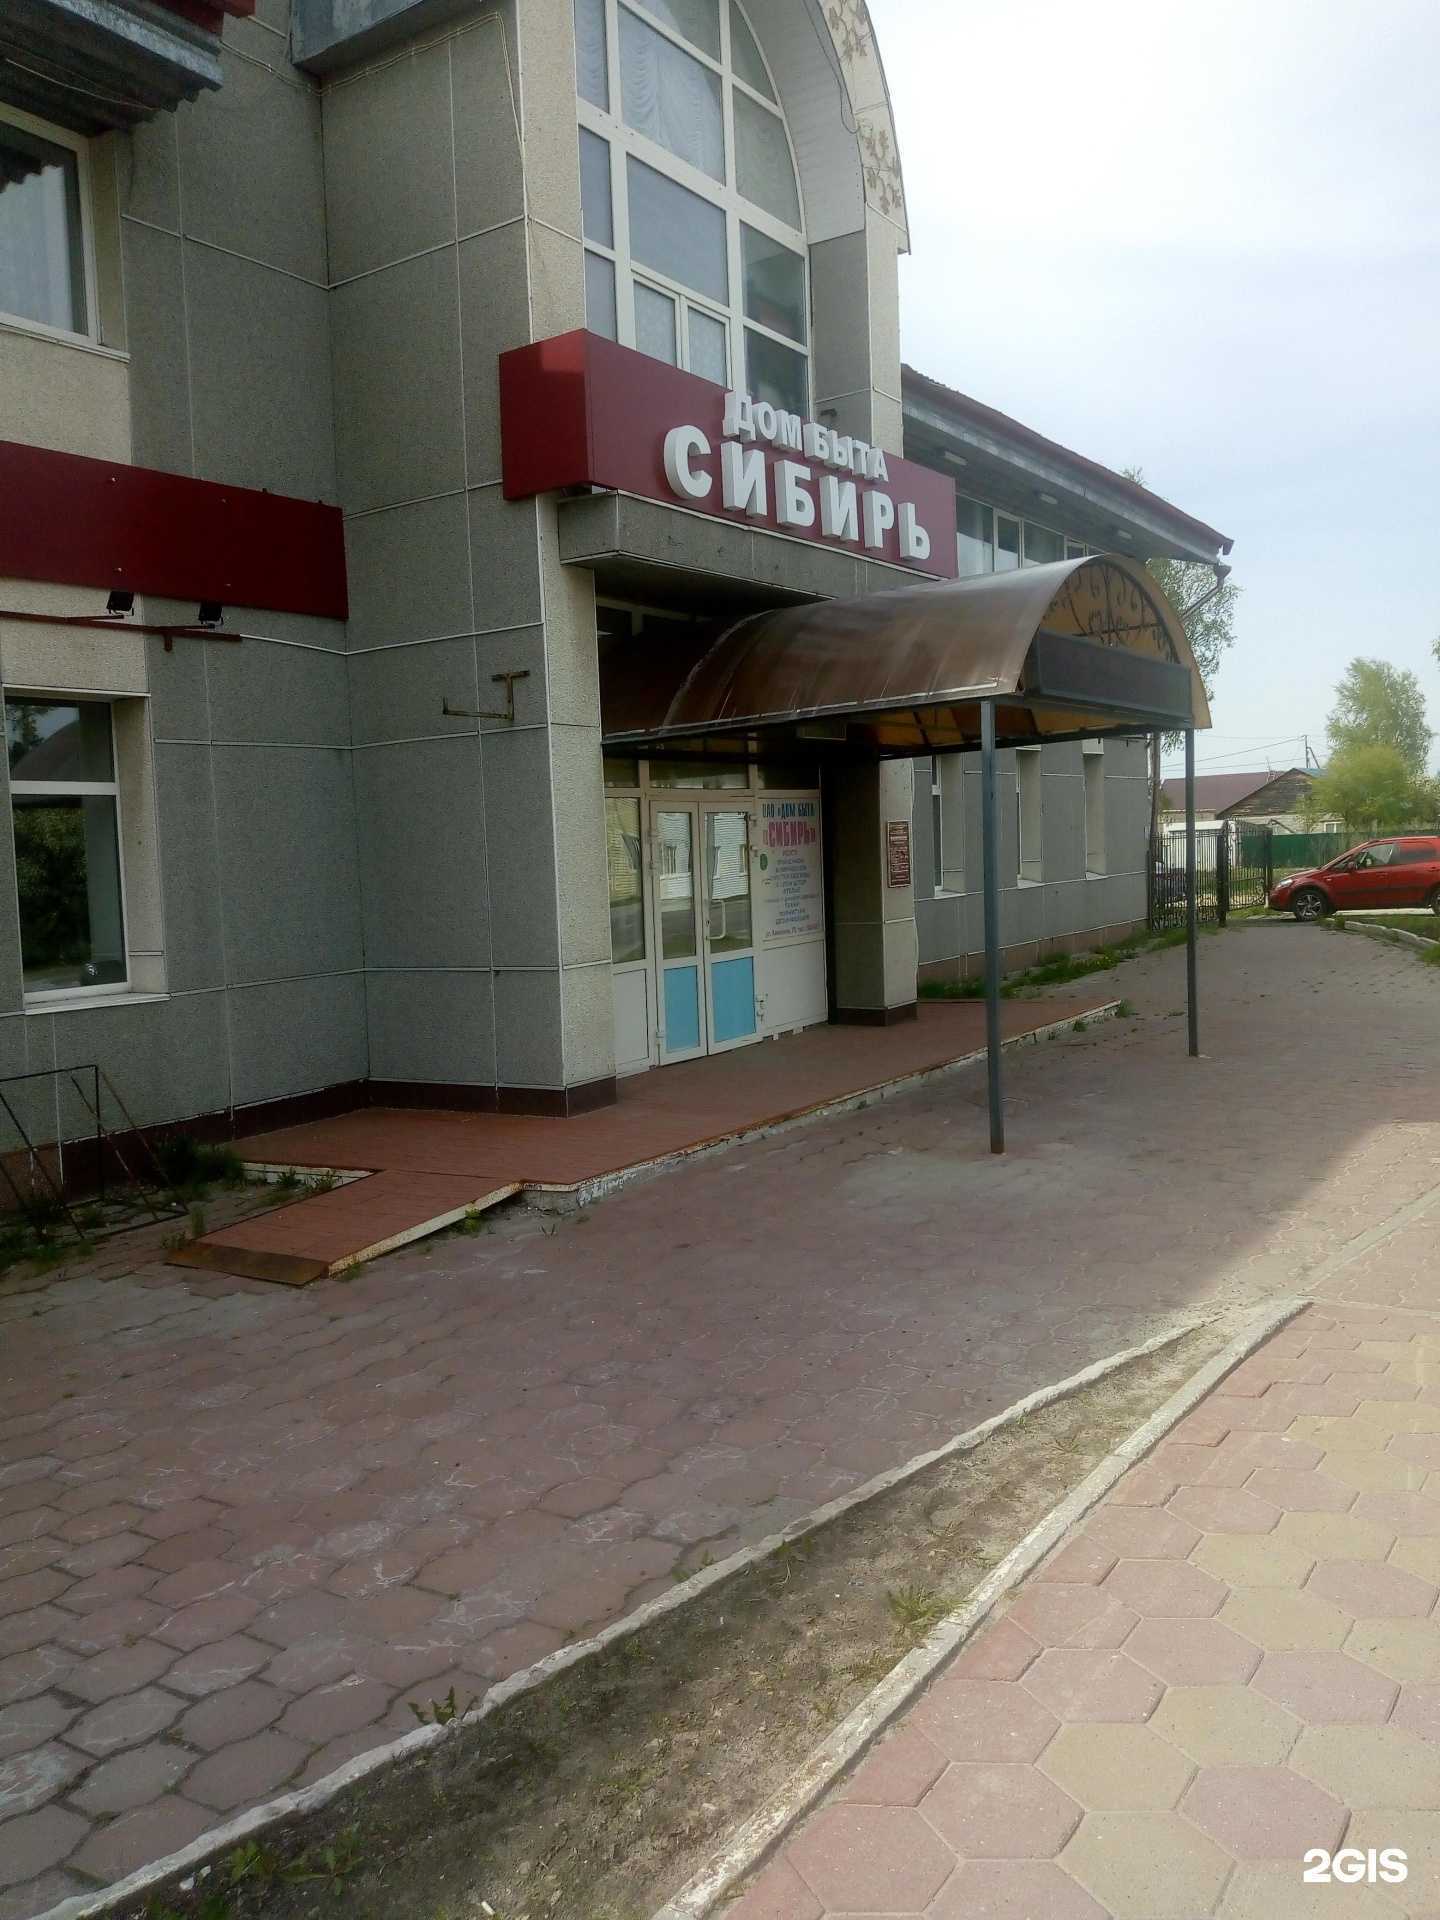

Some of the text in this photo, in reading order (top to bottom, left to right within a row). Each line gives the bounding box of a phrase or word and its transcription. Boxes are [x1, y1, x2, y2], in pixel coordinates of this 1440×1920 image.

[663, 424, 931, 561] СИБИРЬ
[722, 390, 889, 482] ДОМ БЫТА
